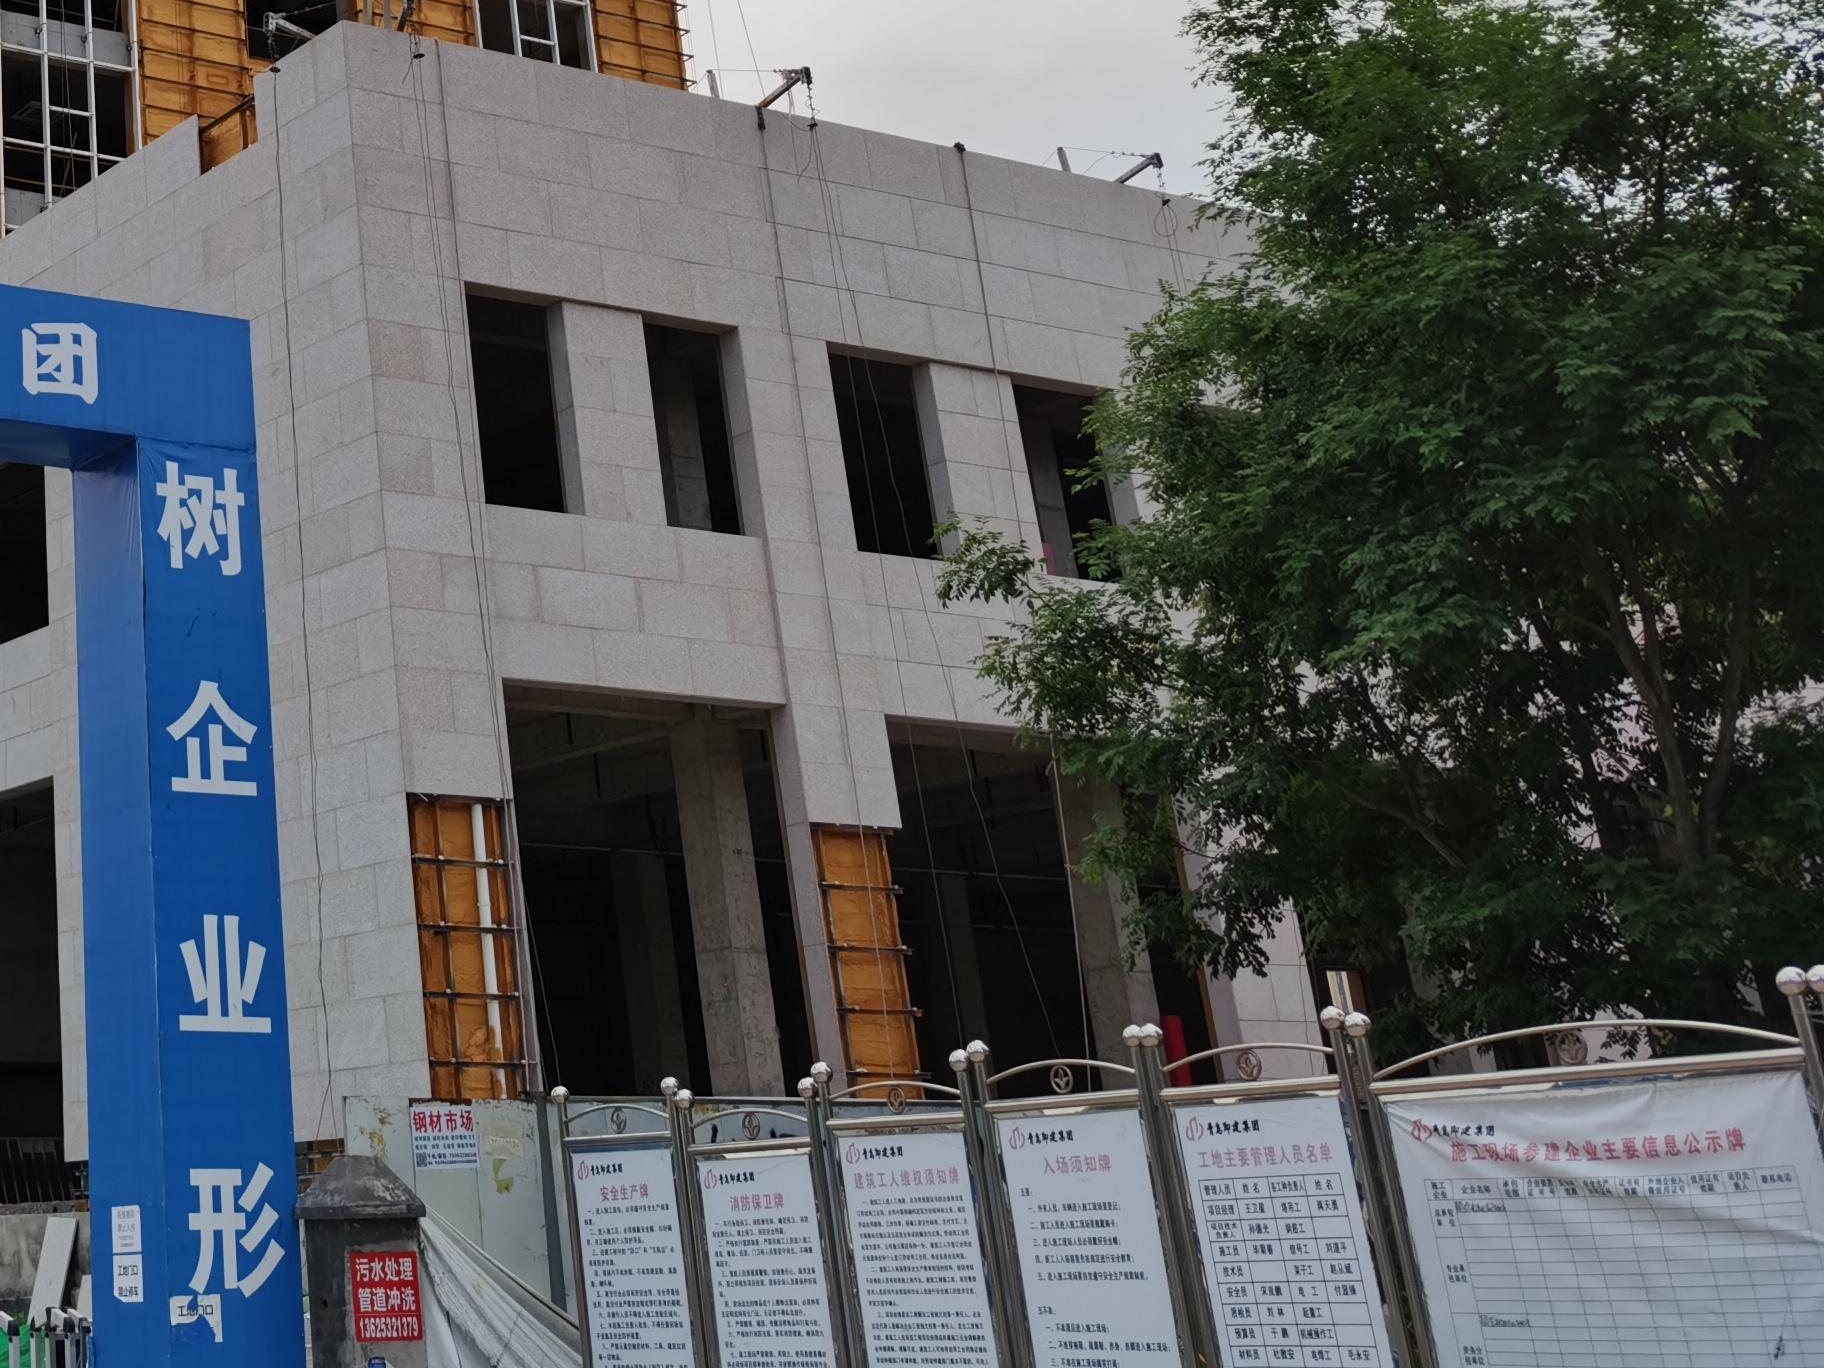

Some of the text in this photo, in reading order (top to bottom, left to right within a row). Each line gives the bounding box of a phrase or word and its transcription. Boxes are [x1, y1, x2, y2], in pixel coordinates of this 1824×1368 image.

[156, 461, 285, 1299] 树企业形
[413, 1109, 474, 1133] 钢材市场
[1198, 1143, 1333, 1168] 工地主要管理人员名单
[1451, 1127, 1746, 1162] 施工现场参建企业主要信息公示牌
[1044, 1154, 1111, 1174] 入场须知牌
[854, 1166, 960, 1189] 建筑工人维权须知牌
[600, 1183, 648, 1201] 安全生产牌
[730, 1192, 784, 1211] 消防保卫牌
[356, 1257, 414, 1282] 污水处理
[358, 1286, 416, 1312] 管道冲洗
[1227, 1286, 1248, 1298] 安全员
[359, 1316, 419, 1338] 13625321379
